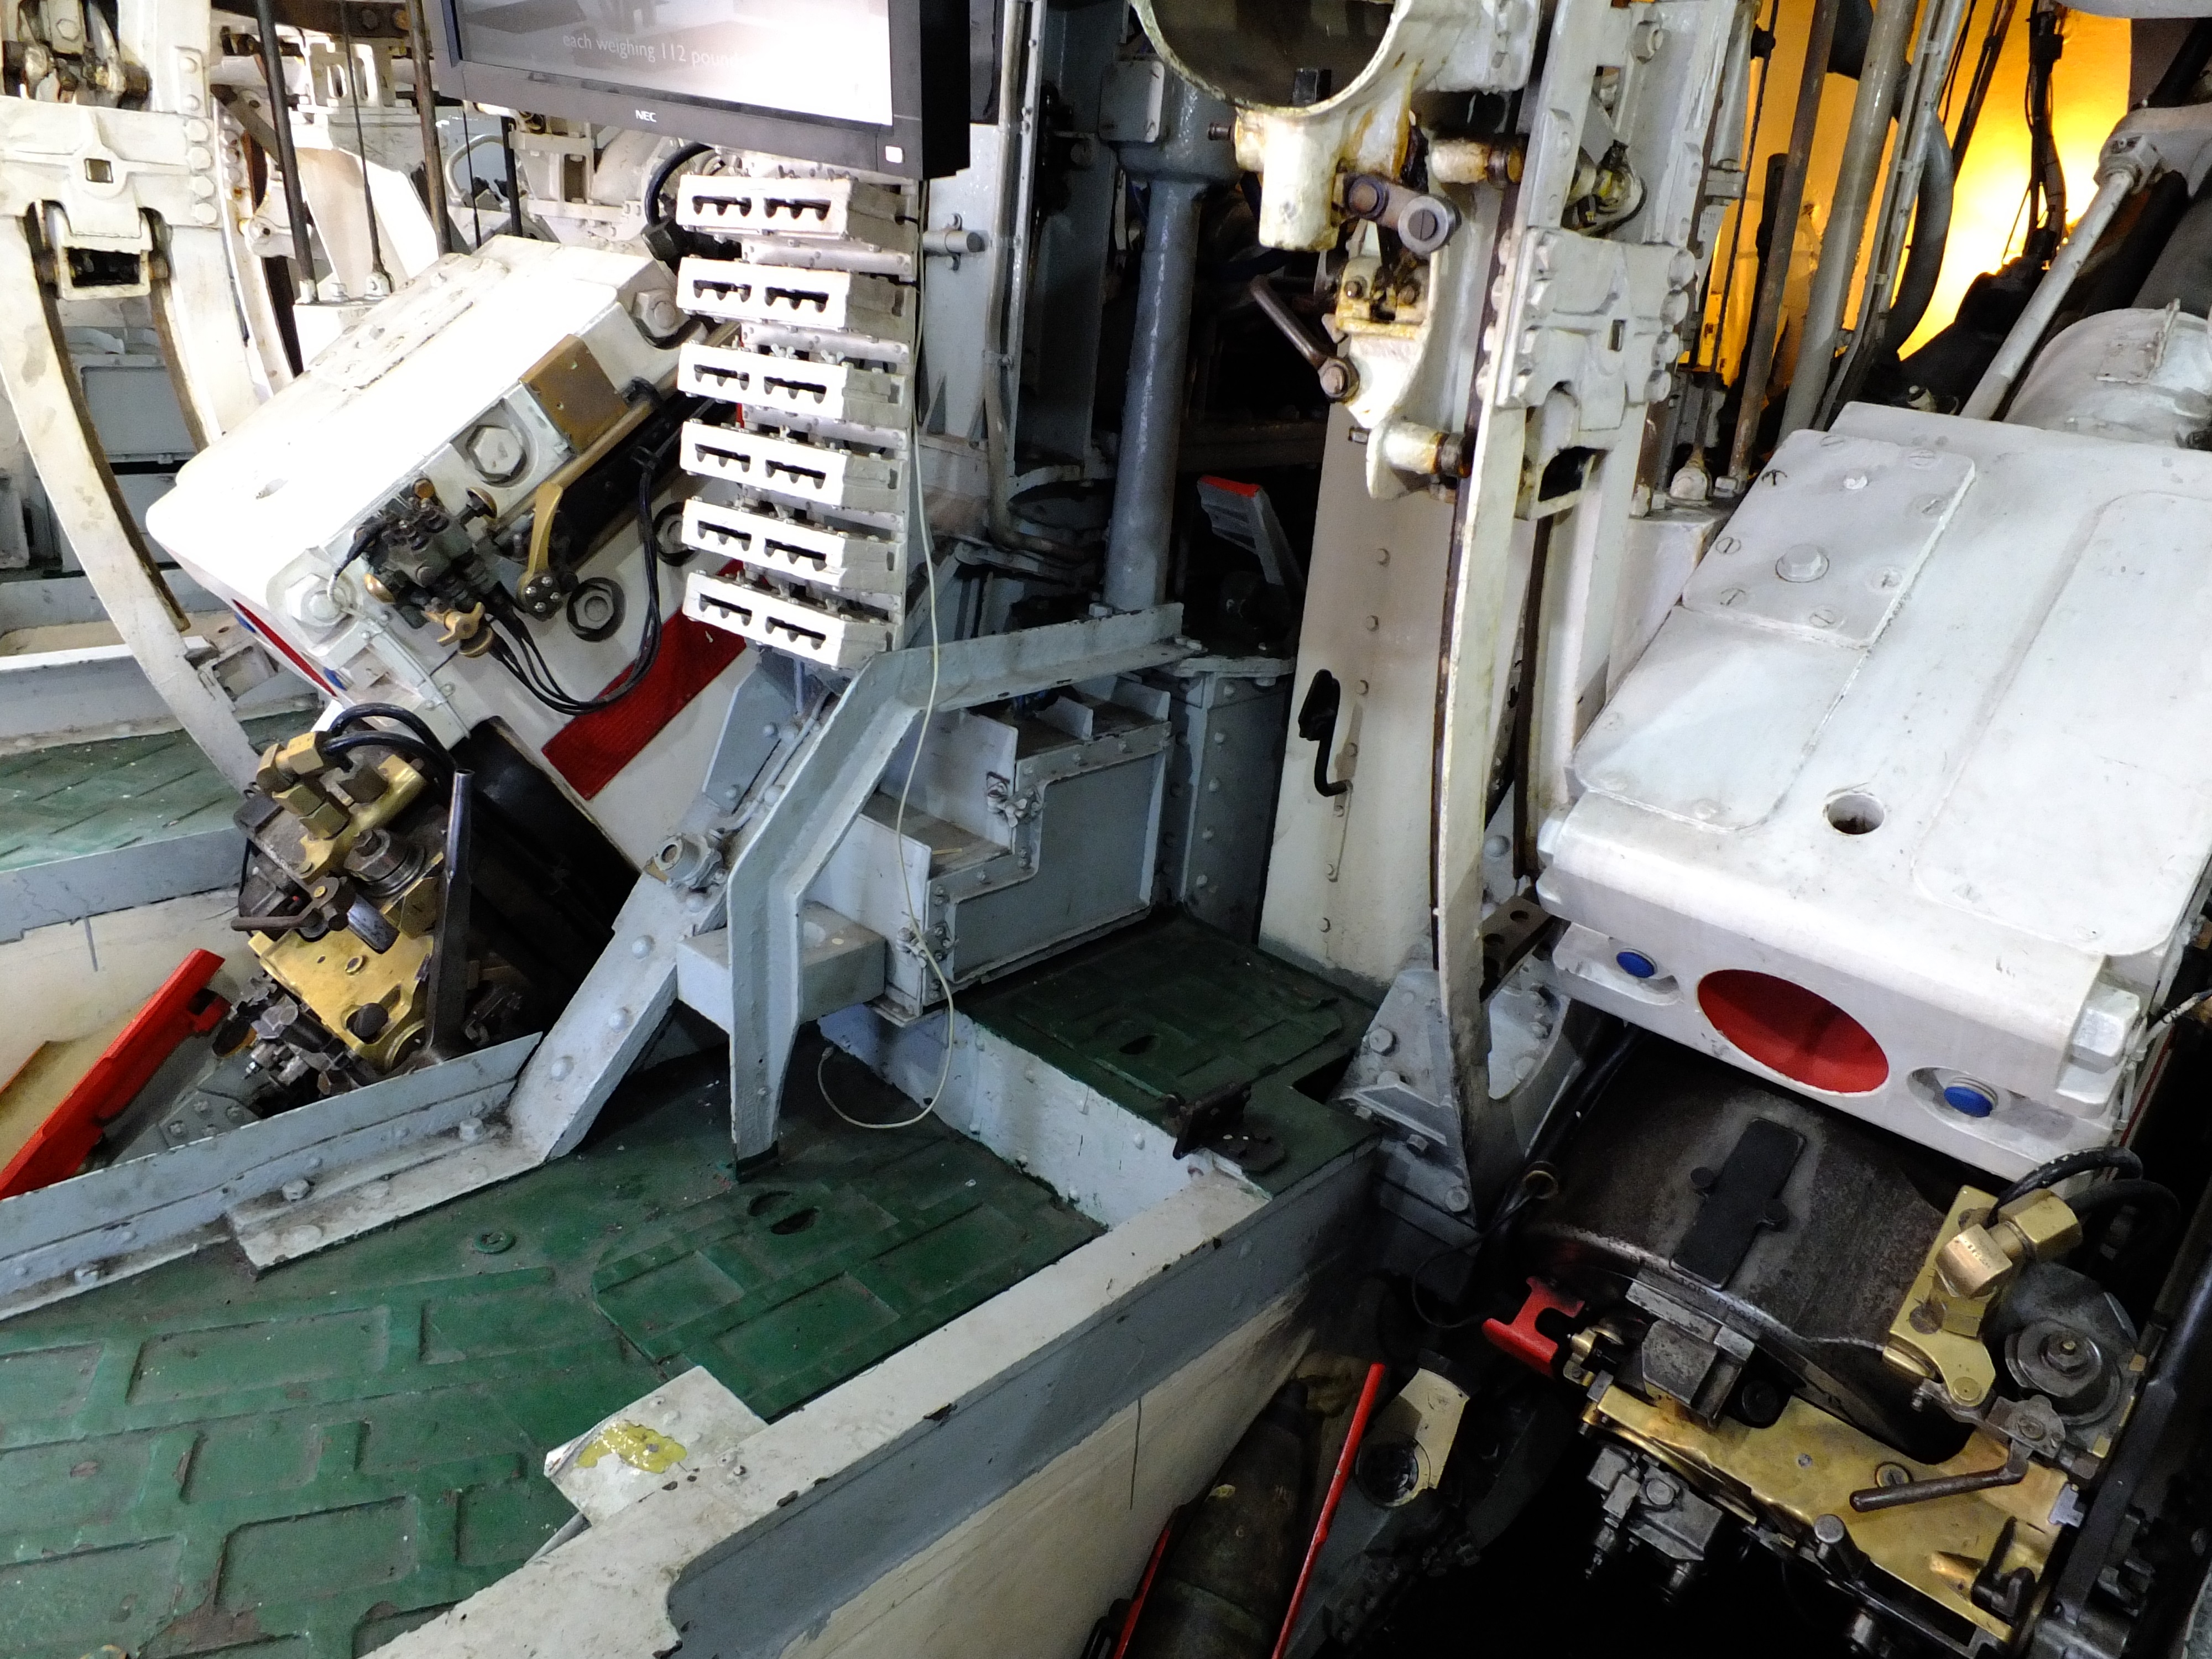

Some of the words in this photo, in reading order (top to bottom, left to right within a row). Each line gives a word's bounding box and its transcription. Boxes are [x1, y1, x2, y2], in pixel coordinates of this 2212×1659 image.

[563, 33, 592, 50] each
[597, 38, 656, 62] weighing
[661, 43, 686, 62] 112
[635, 109, 657, 123] NEC
